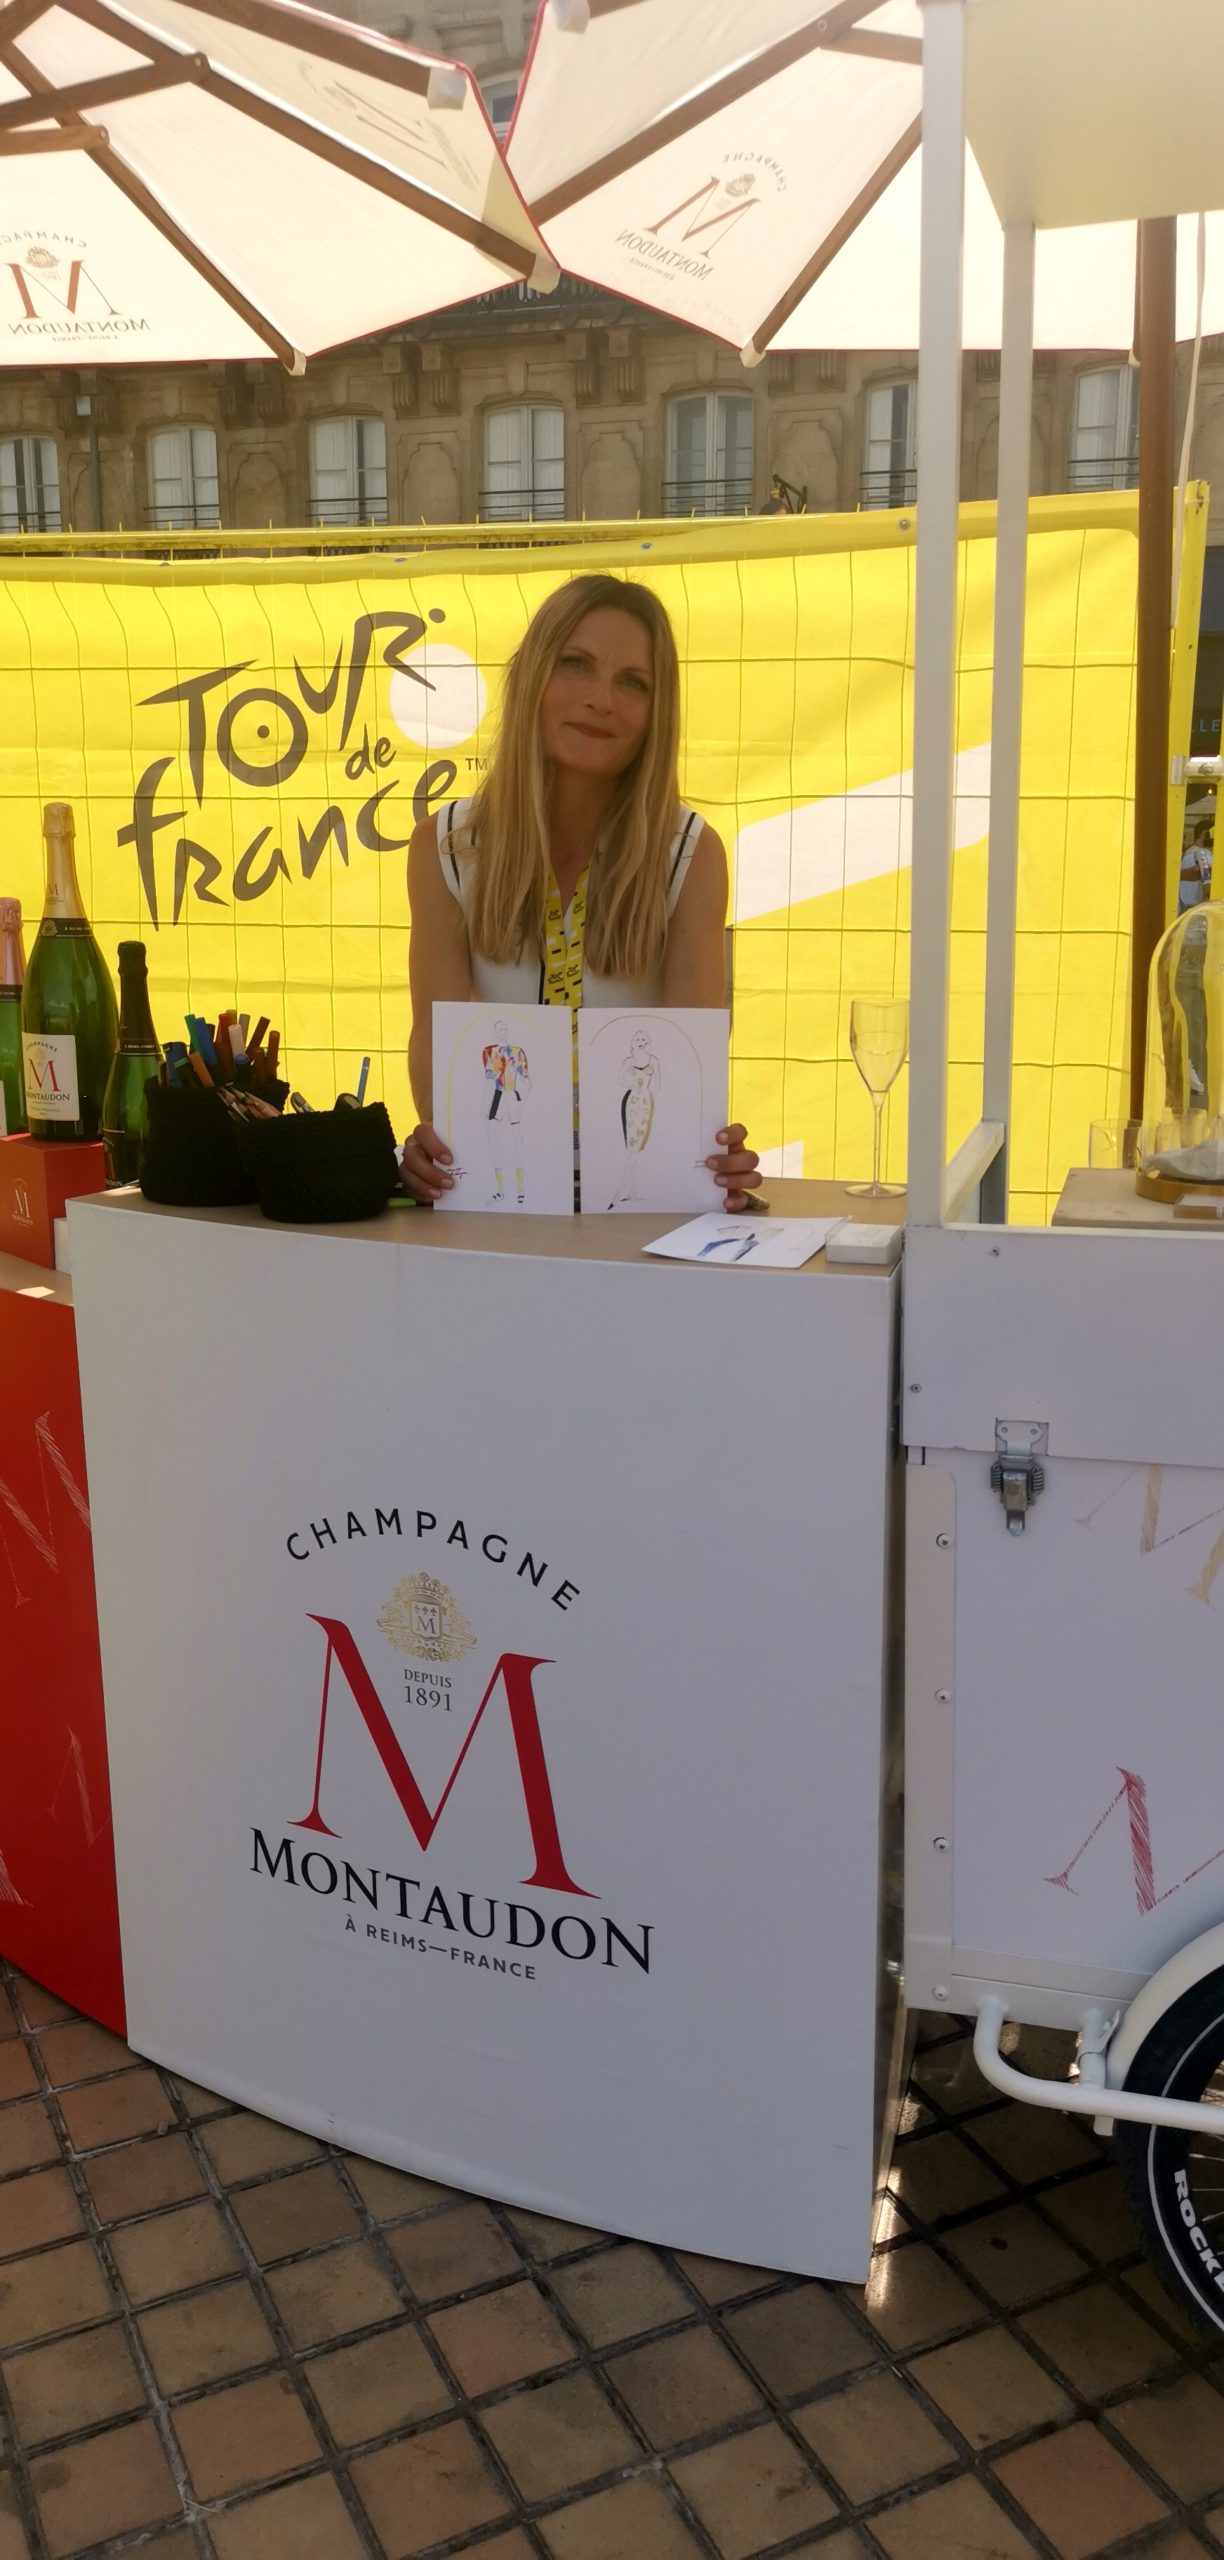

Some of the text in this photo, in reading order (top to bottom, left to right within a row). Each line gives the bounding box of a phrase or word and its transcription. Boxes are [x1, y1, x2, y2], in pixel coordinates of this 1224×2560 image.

[345, 723, 397, 780] de
[286, 1508, 581, 1611] CHAMPAGNE
[404, 1668, 453, 1689] DEPUIS
[404, 1685, 453, 1712] 1891
[287, 1613, 602, 1900] M
[248, 1827, 656, 1975] MONTAUDON
[344, 1913, 357, 1933] À
